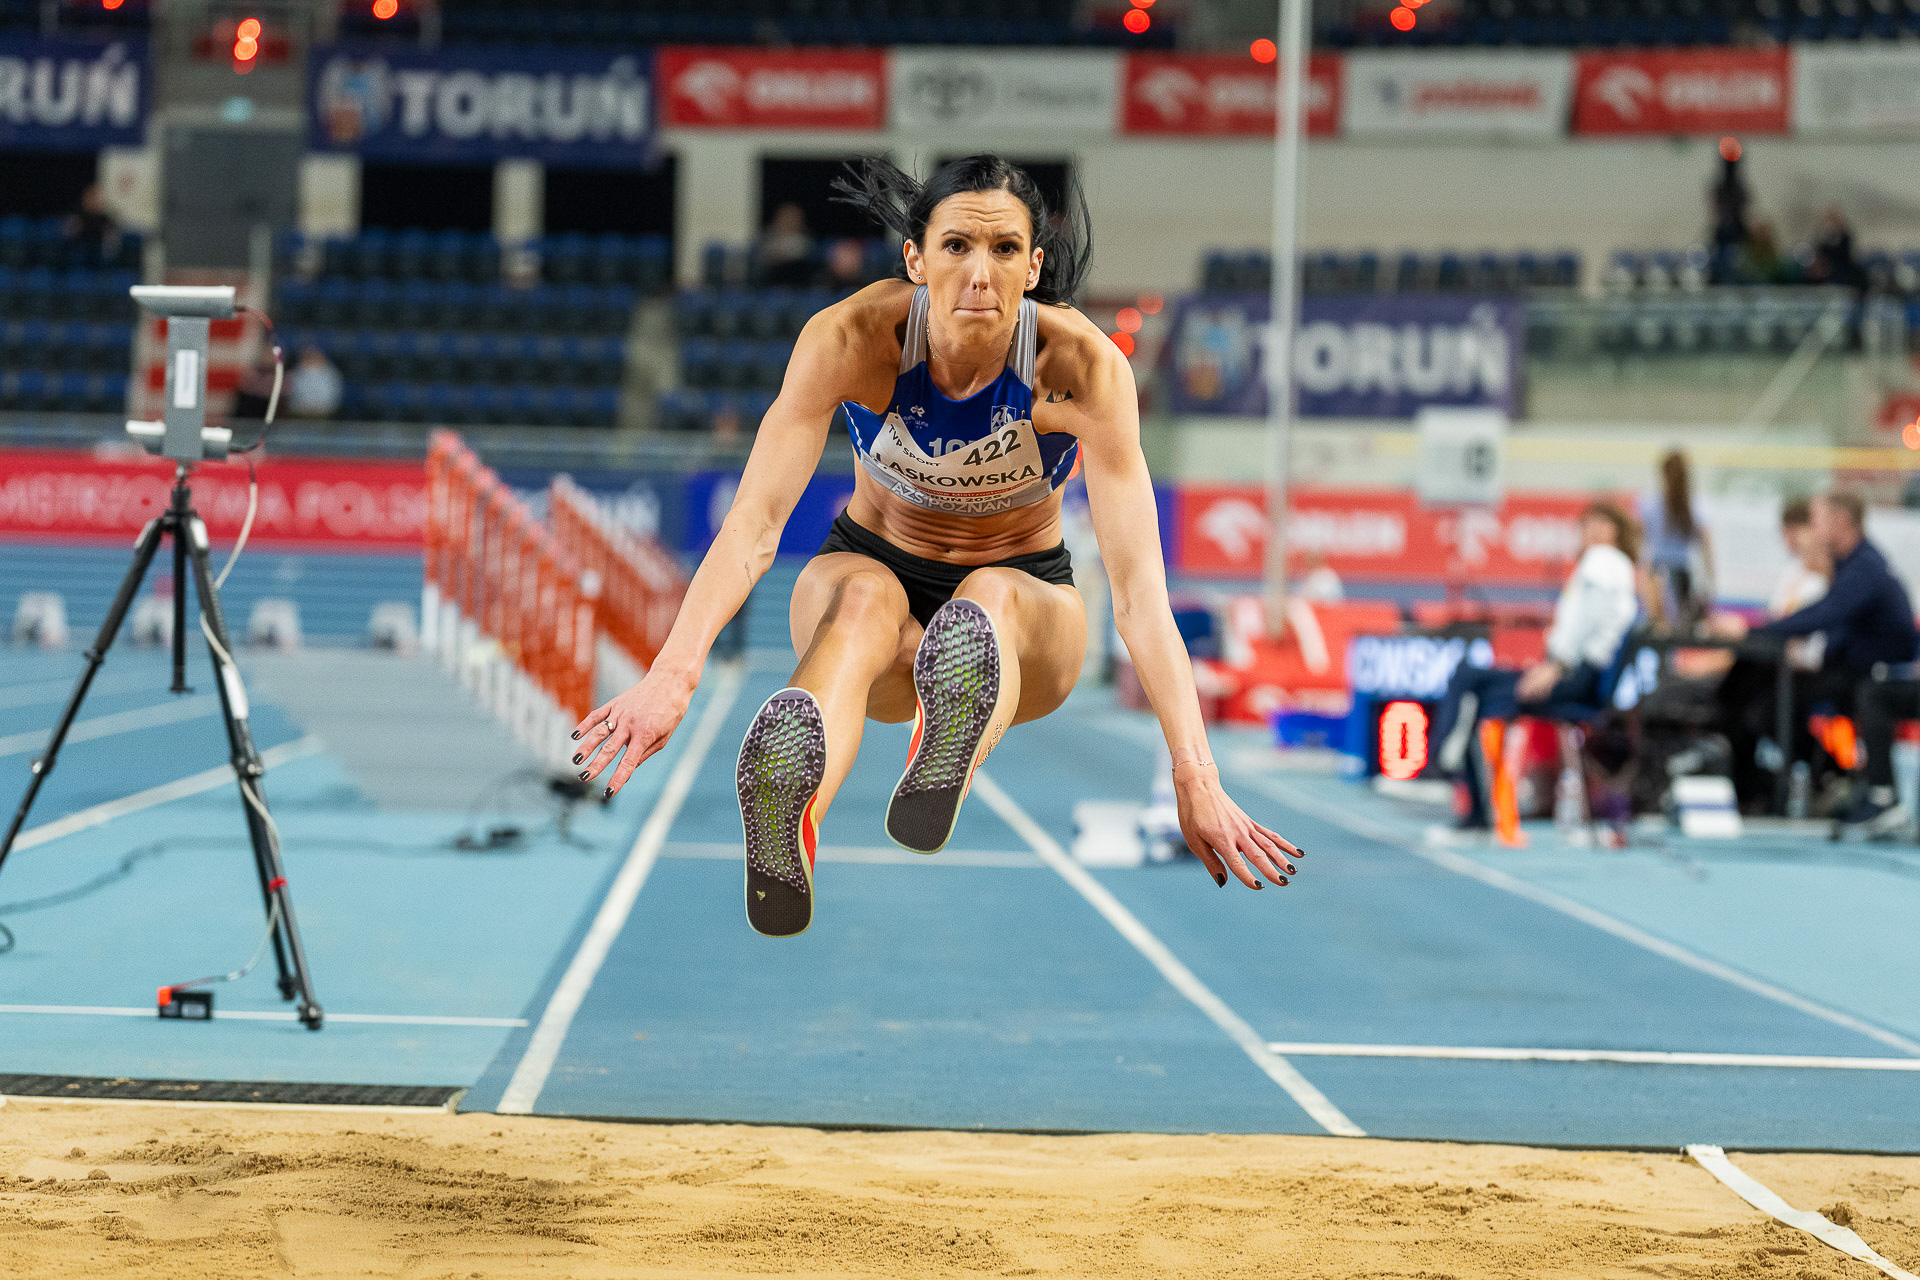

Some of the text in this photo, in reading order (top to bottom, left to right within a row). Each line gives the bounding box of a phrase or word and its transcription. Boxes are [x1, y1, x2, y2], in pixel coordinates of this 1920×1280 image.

[396, 56, 649, 141] TORUŃ
[1202, 72, 1333, 114] ORLN
[888, 423, 942, 467] TVP SPORT
[928, 437, 977, 459] 10
[962, 429, 1022, 466] 422
[890, 481, 924, 504] AZS
[1379, 700, 1429, 780] 0
